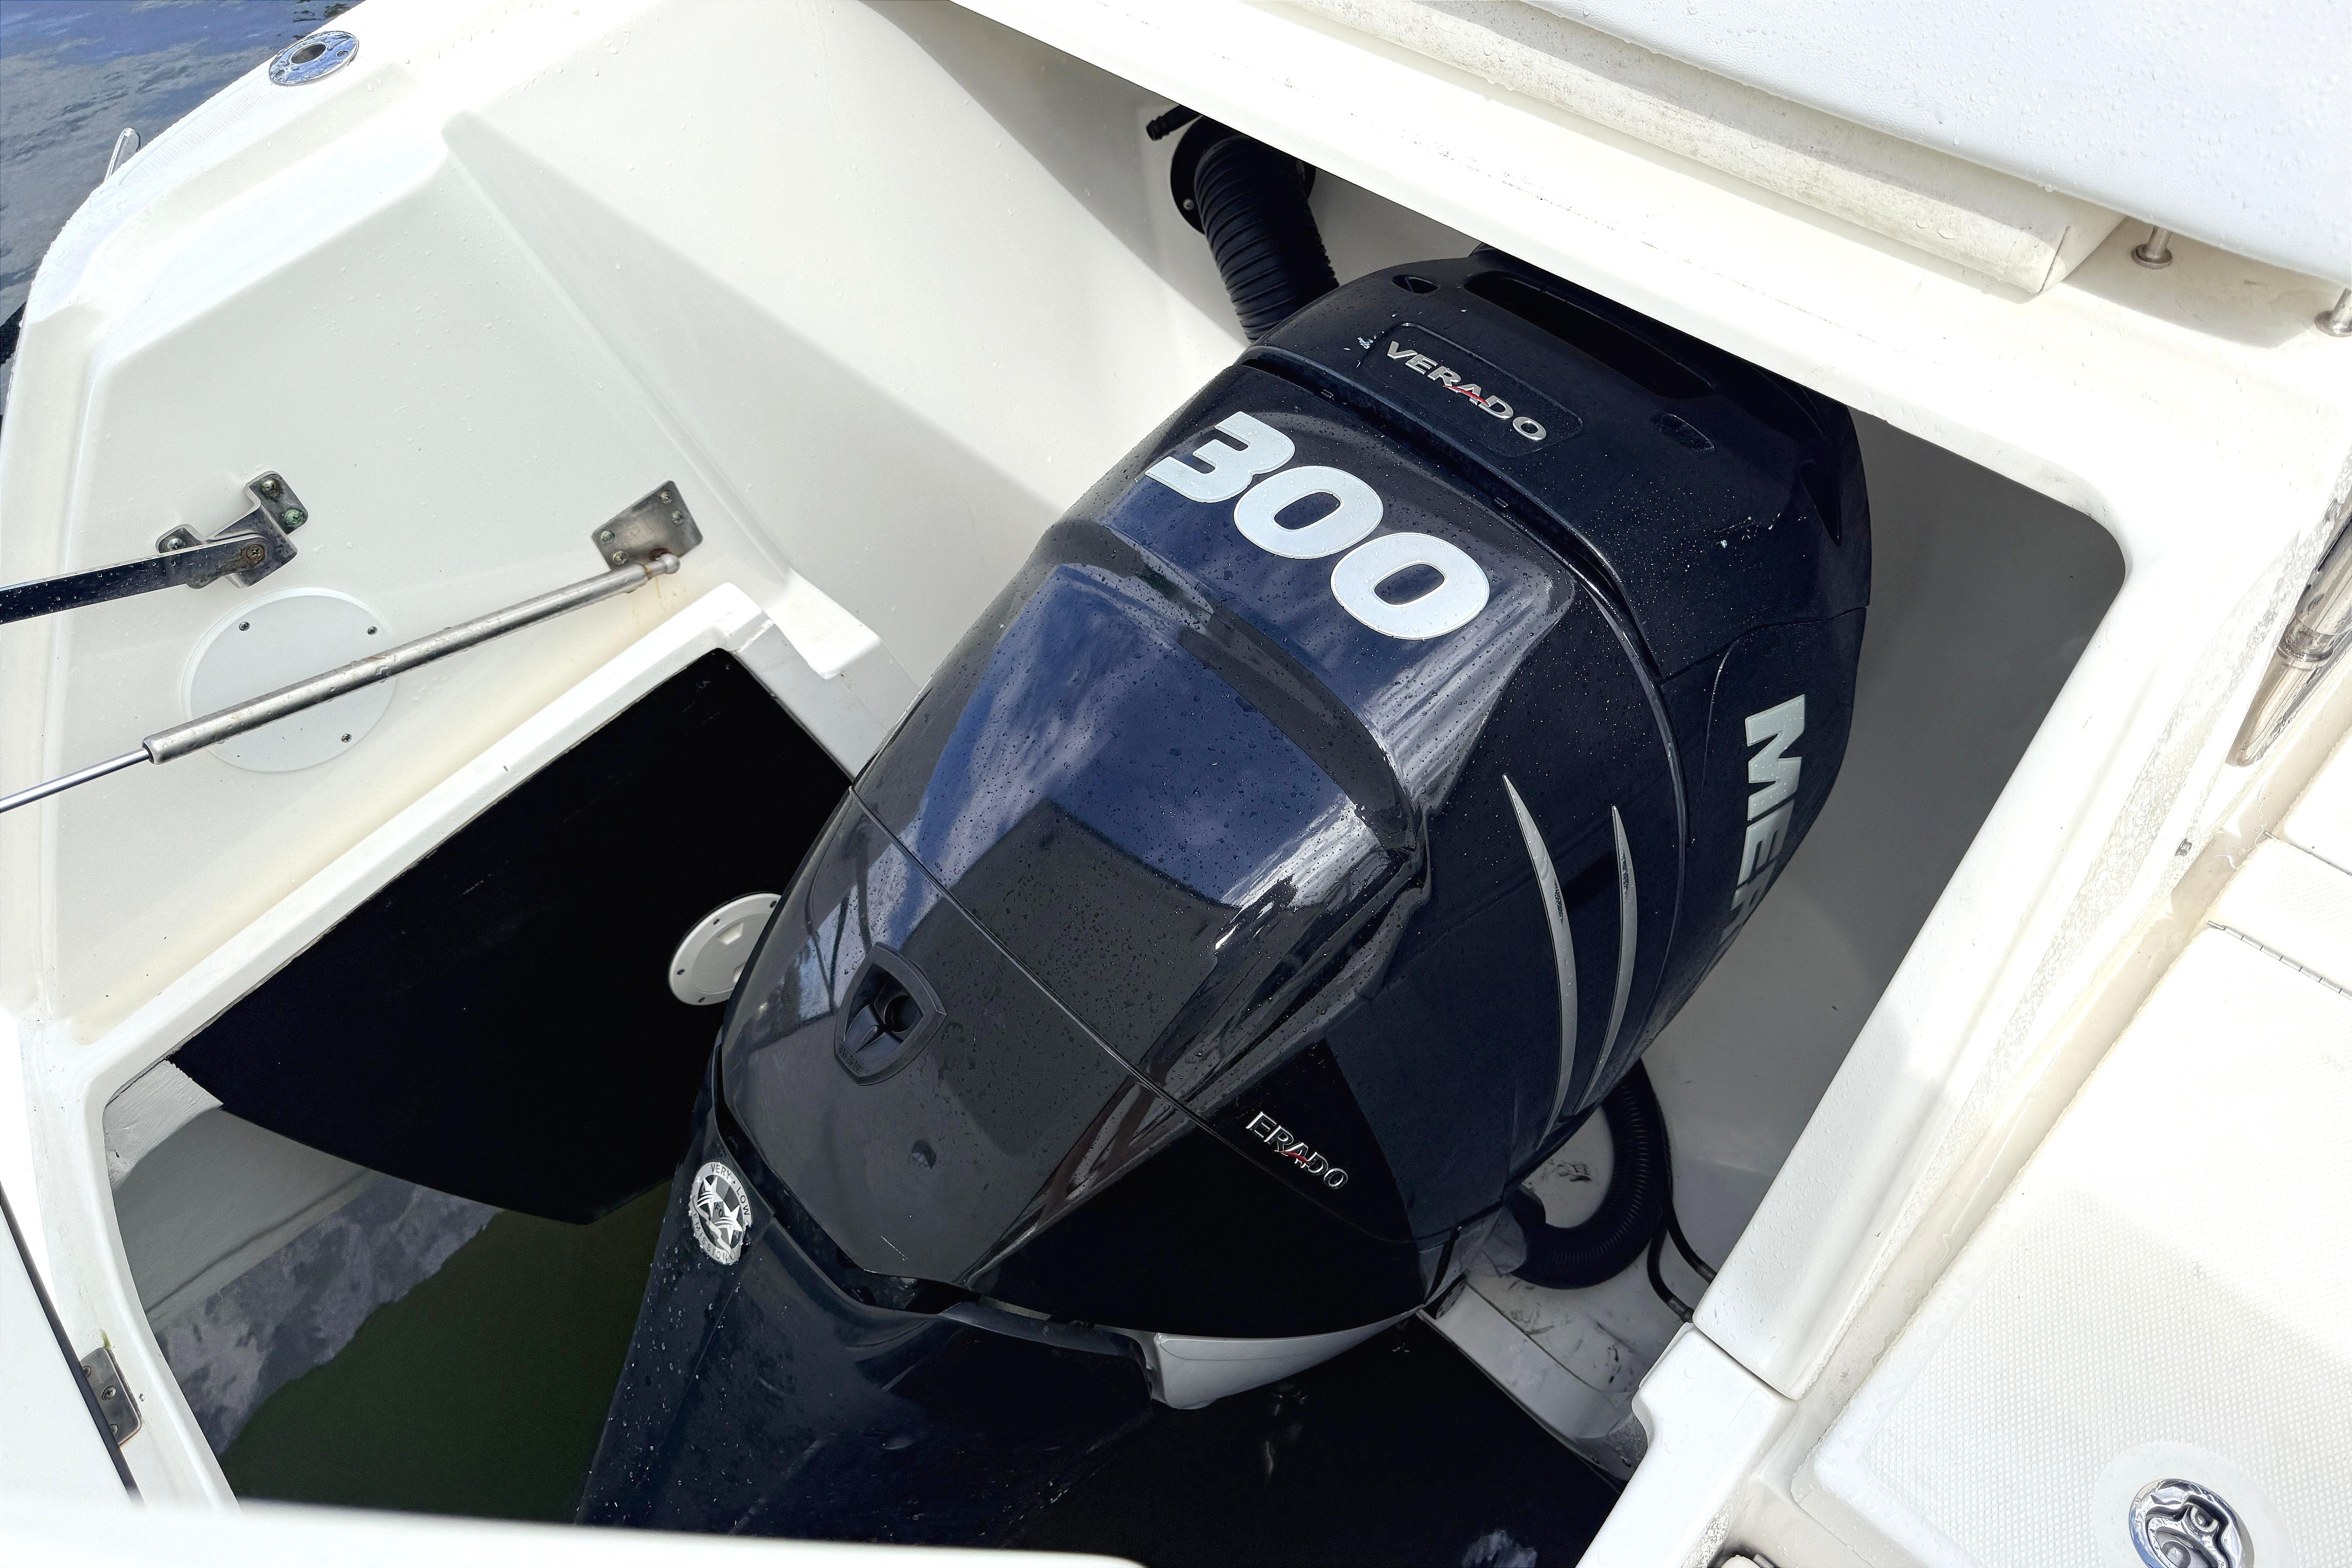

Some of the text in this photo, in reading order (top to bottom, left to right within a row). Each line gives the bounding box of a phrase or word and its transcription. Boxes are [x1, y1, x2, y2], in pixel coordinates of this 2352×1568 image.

[1387, 341, 1547, 441] VERADO
[1144, 411, 1490, 640] 300
[711, 1163, 750, 1215] VERY LOW
[693, 1213, 728, 1262] EMISSION
